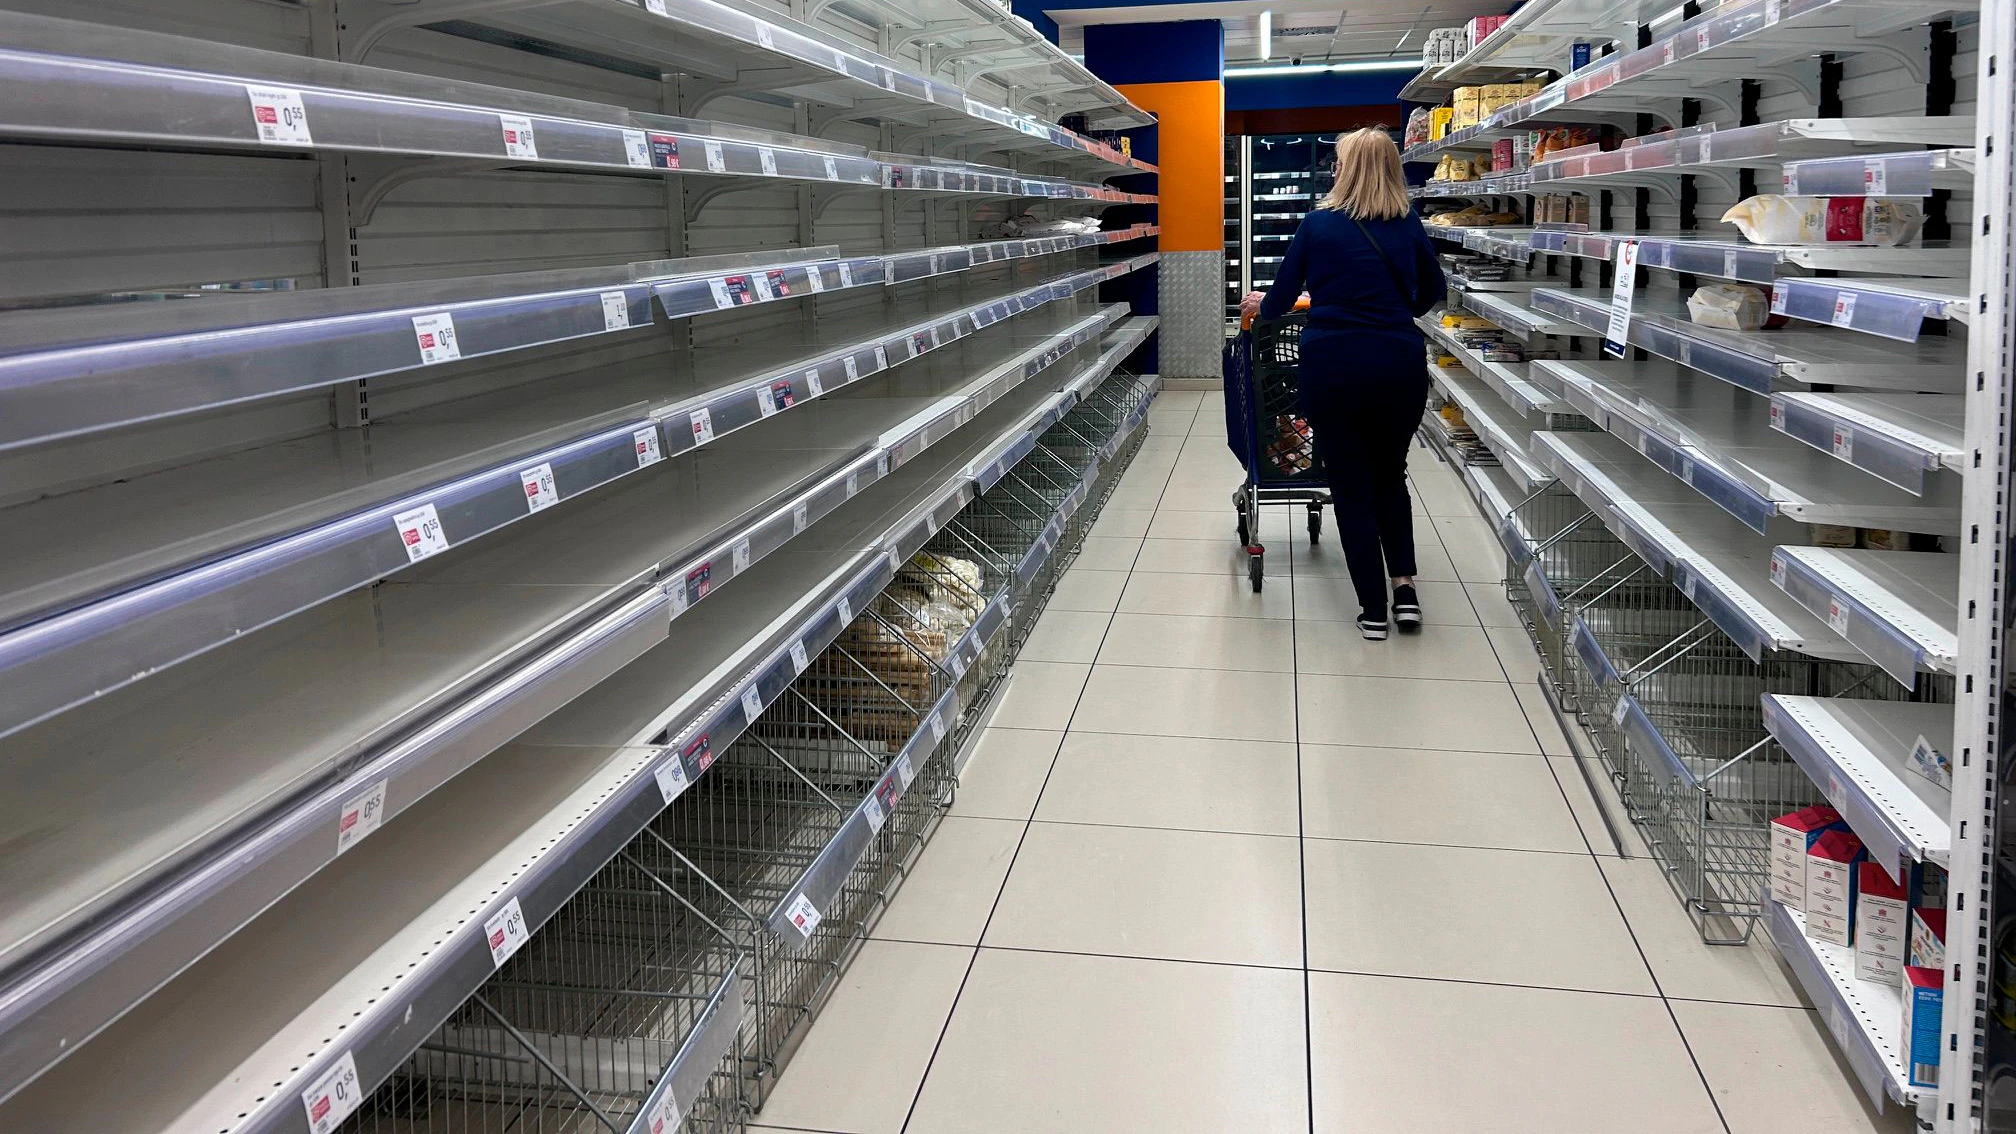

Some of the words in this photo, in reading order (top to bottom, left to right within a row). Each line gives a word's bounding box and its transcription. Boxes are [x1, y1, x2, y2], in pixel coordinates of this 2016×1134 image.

[423, 519, 439, 542] 0,55
[507, 910, 521, 936] 0,55
[336, 1069, 354, 1101] 0,55
